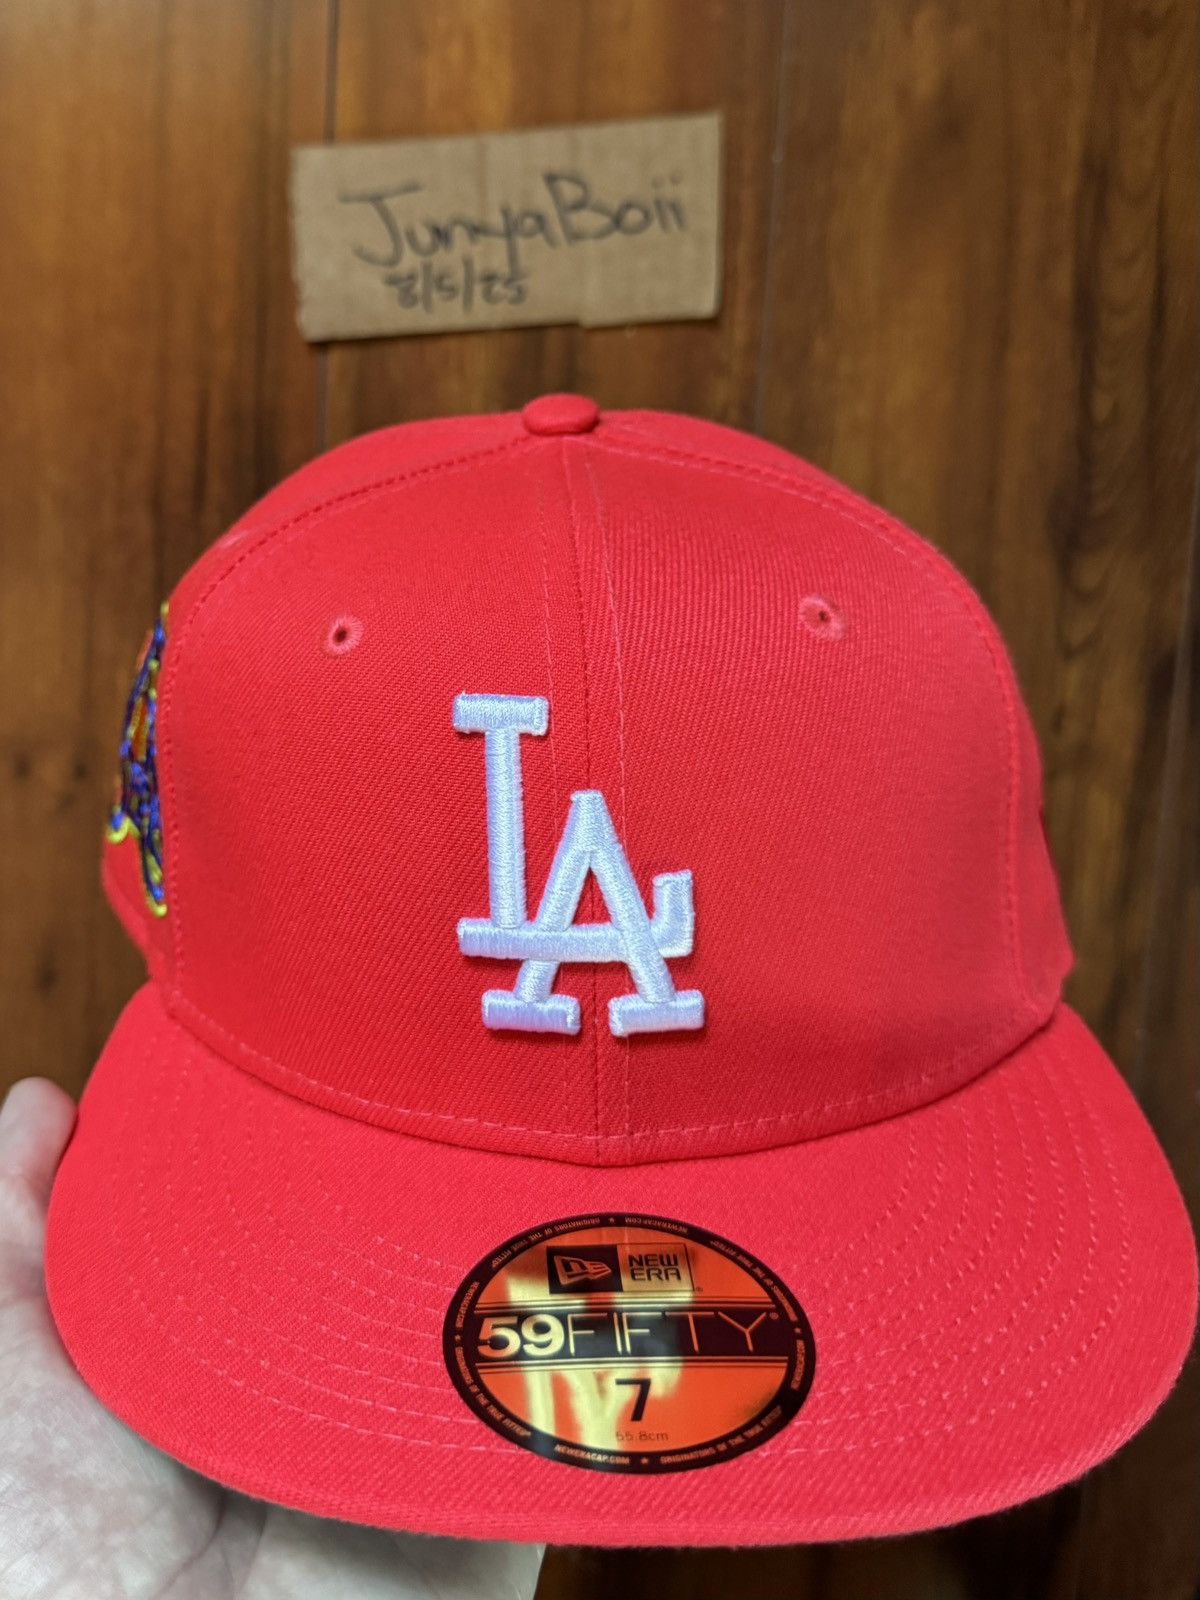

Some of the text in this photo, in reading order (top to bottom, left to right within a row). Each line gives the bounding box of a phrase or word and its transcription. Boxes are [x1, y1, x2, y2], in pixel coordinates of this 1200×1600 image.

[452, 692, 705, 1038] LA
[627, 1253, 679, 1267] NEW
[630, 1267, 682, 1281] ERA
[476, 1310, 768, 1359] 59FIFTY
[614, 1377, 651, 1422] 7
